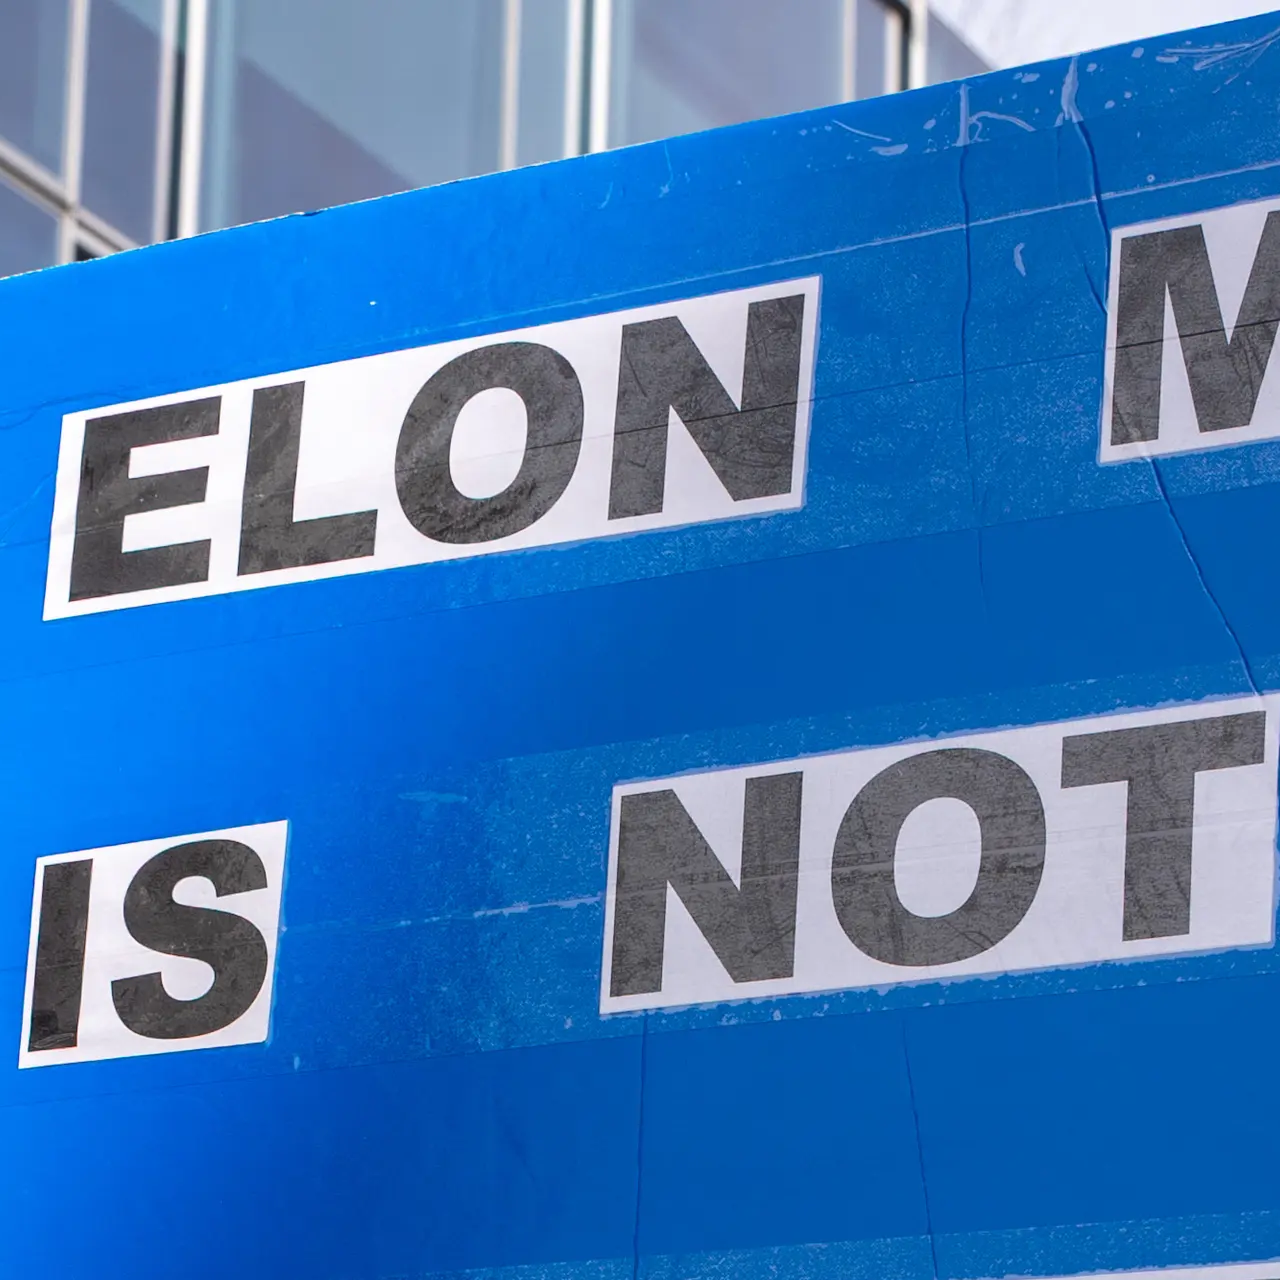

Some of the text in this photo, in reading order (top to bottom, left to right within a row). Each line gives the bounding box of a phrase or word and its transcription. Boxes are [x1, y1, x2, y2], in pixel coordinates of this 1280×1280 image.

[68, 293, 806, 602] ELON
[26, 838, 270, 1053] IS
[609, 711, 1267, 998] NOT
